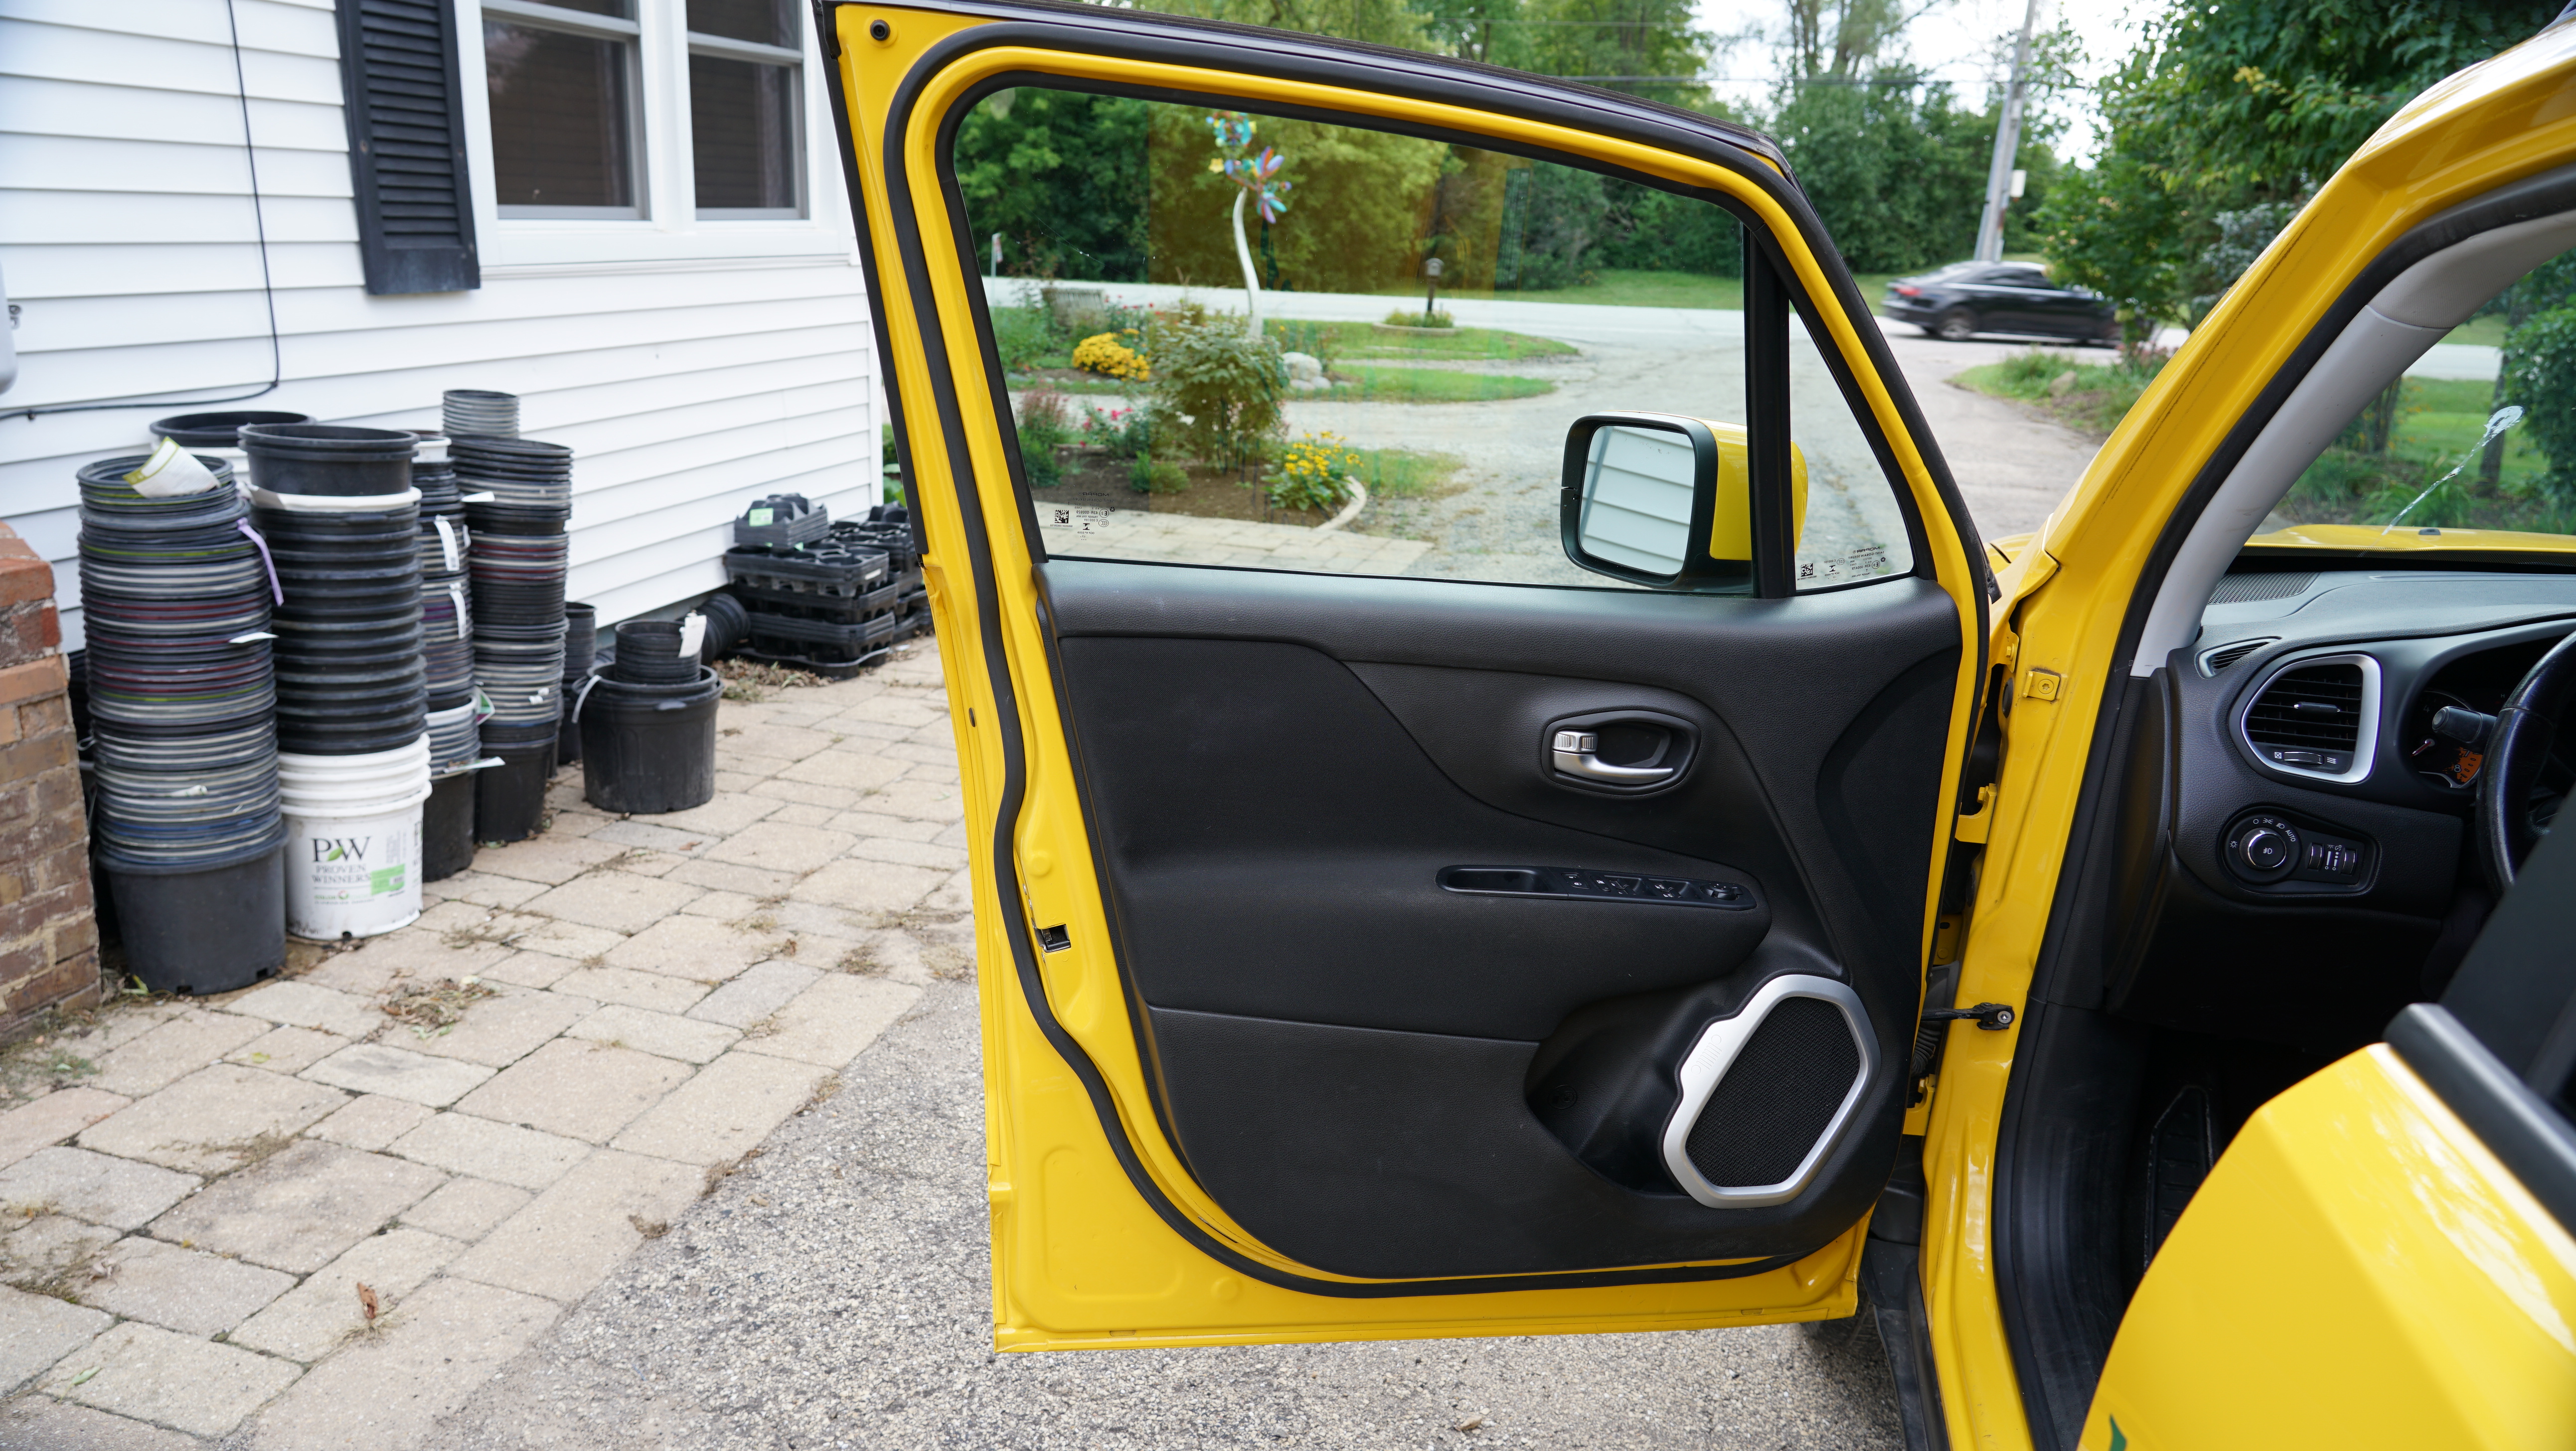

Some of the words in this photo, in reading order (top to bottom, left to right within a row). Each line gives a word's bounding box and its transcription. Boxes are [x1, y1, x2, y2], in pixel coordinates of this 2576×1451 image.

[2423, 705, 2429, 713] 4
[2453, 764, 2462, 773] 8
[2285, 830, 2296, 842] AUTO
[311, 836, 371, 862] PW
[316, 864, 366, 873] PROVEN
[312, 873, 371, 883] WINNERS
